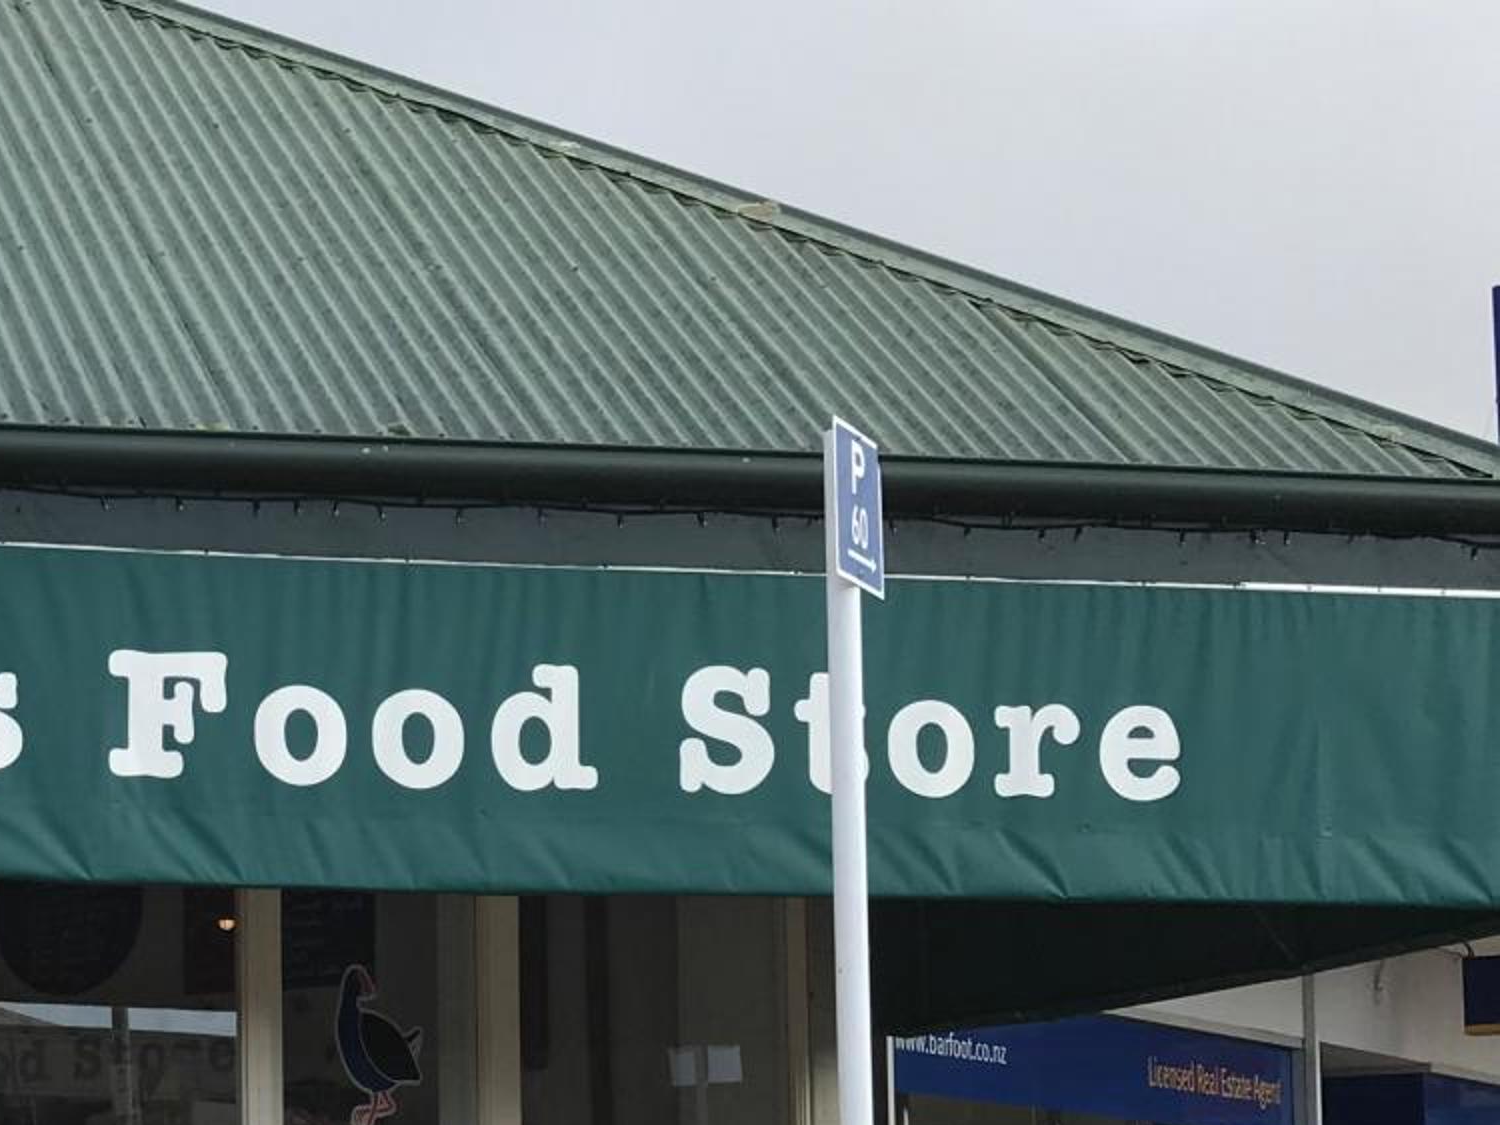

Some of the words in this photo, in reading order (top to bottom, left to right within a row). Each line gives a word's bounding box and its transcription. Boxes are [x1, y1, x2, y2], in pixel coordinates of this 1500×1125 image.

[851, 440, 866, 496] P
[851, 504, 869, 550] 60
[107, 648, 599, 790] Food
[679, 665, 1181, 801] Store
[1147, 1055, 1195, 1092] Licensed
[1196, 1063, 1221, 1096] Real
[1221, 1067, 1252, 1101] Estate
[1252, 1073, 1282, 1110] Agent
